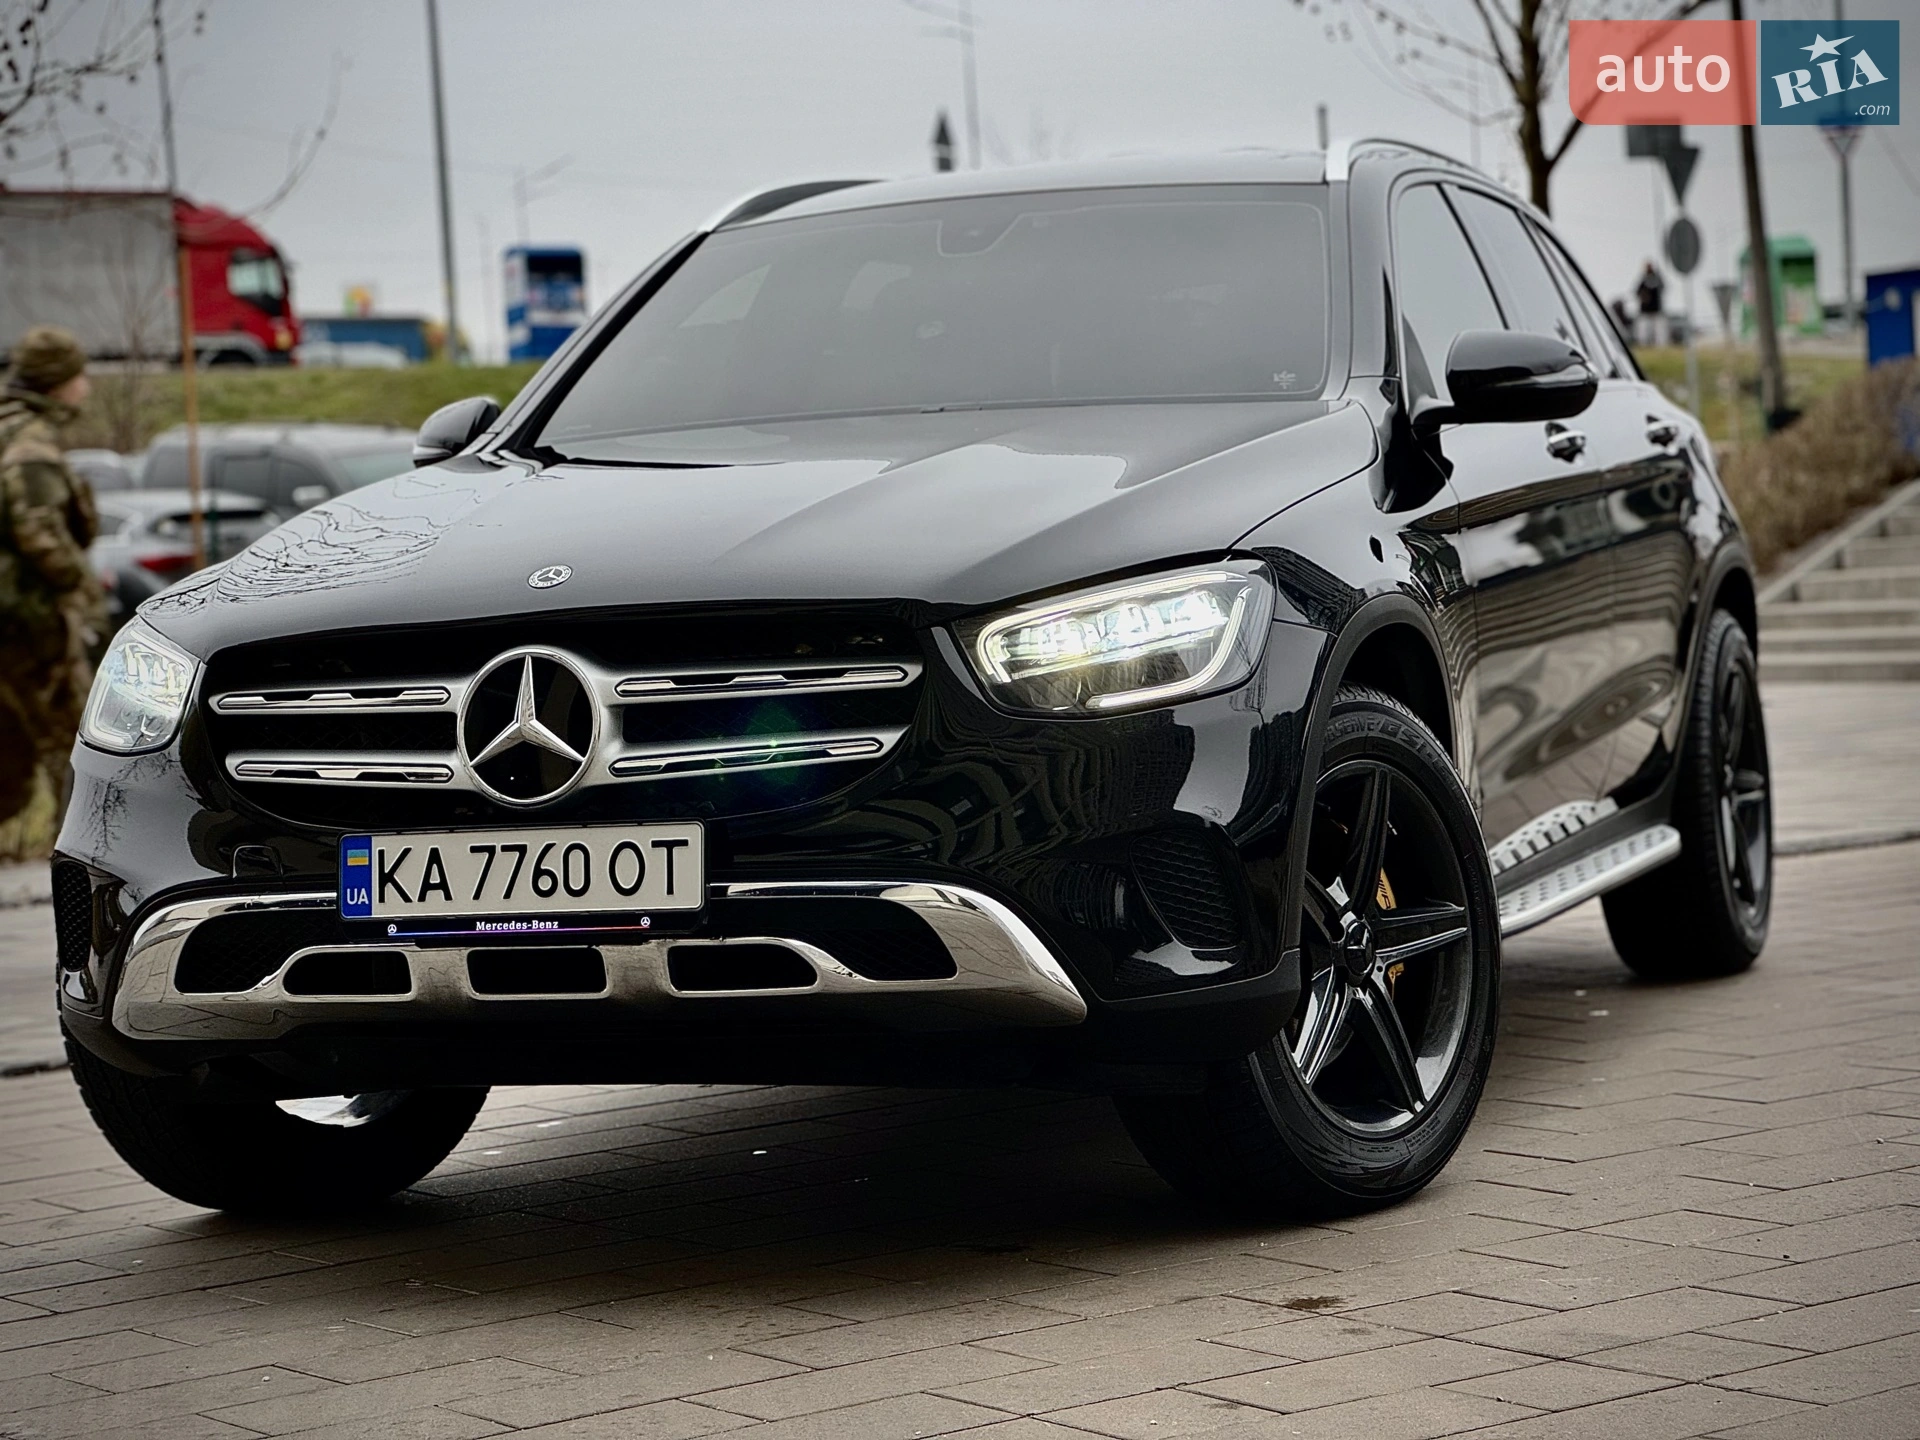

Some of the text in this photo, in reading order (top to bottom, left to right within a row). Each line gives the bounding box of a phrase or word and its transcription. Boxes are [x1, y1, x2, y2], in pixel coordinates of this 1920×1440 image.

[376, 838, 690, 904] KA 7760 OT
[346, 887, 370, 905] UA
[475, 919, 560, 932] Mercedes-Benz
